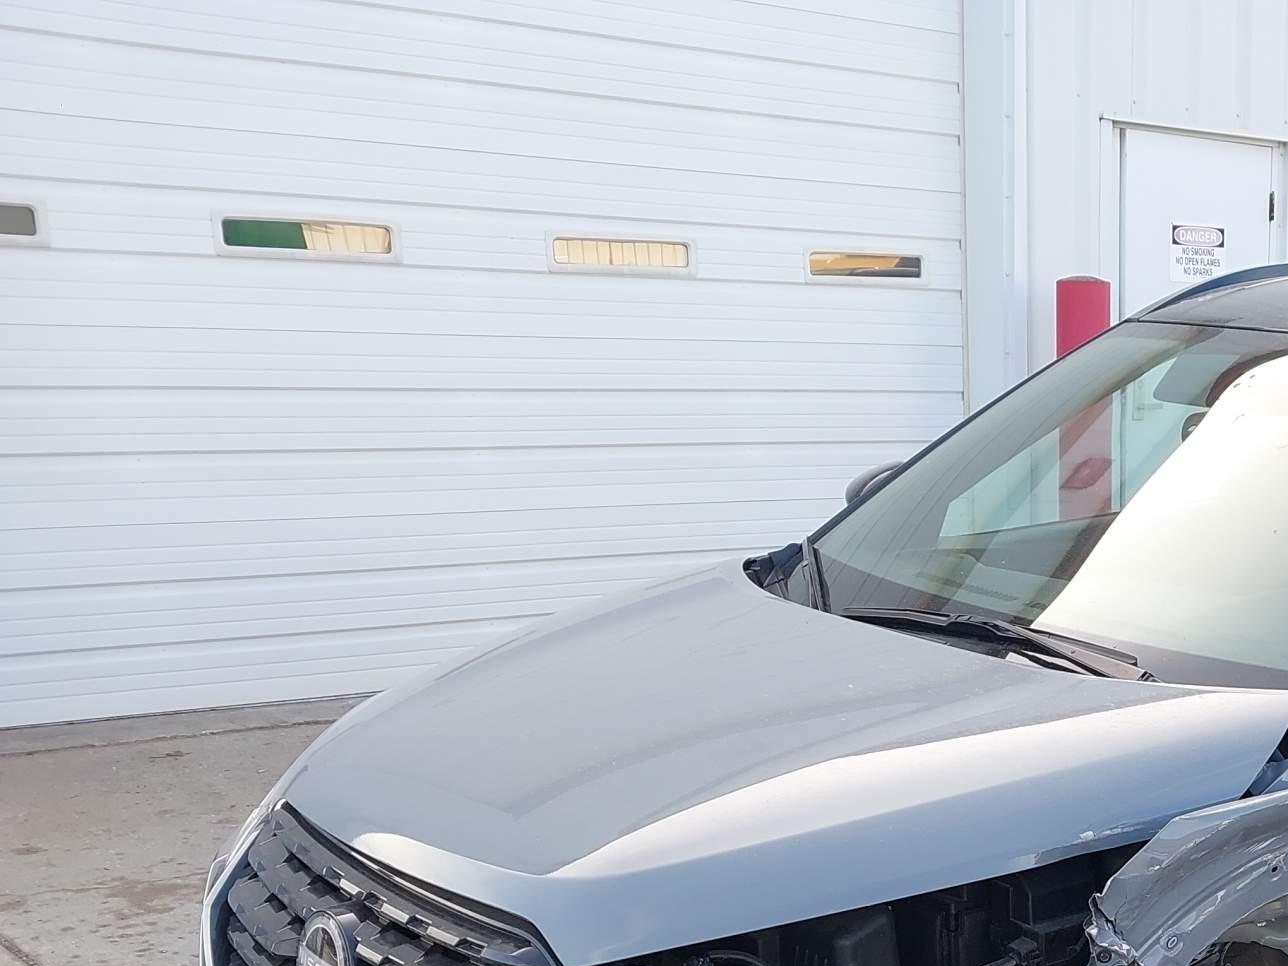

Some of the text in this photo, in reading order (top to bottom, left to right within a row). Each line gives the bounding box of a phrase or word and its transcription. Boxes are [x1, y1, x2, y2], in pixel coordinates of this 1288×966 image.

[1179, 230, 1217, 242] DANGER
[1181, 247, 1215, 257] NO SMOKING
[1175, 256, 1221, 268] NO OPEN FLAMES
[1183, 266, 1213, 277] NO SPARKS
